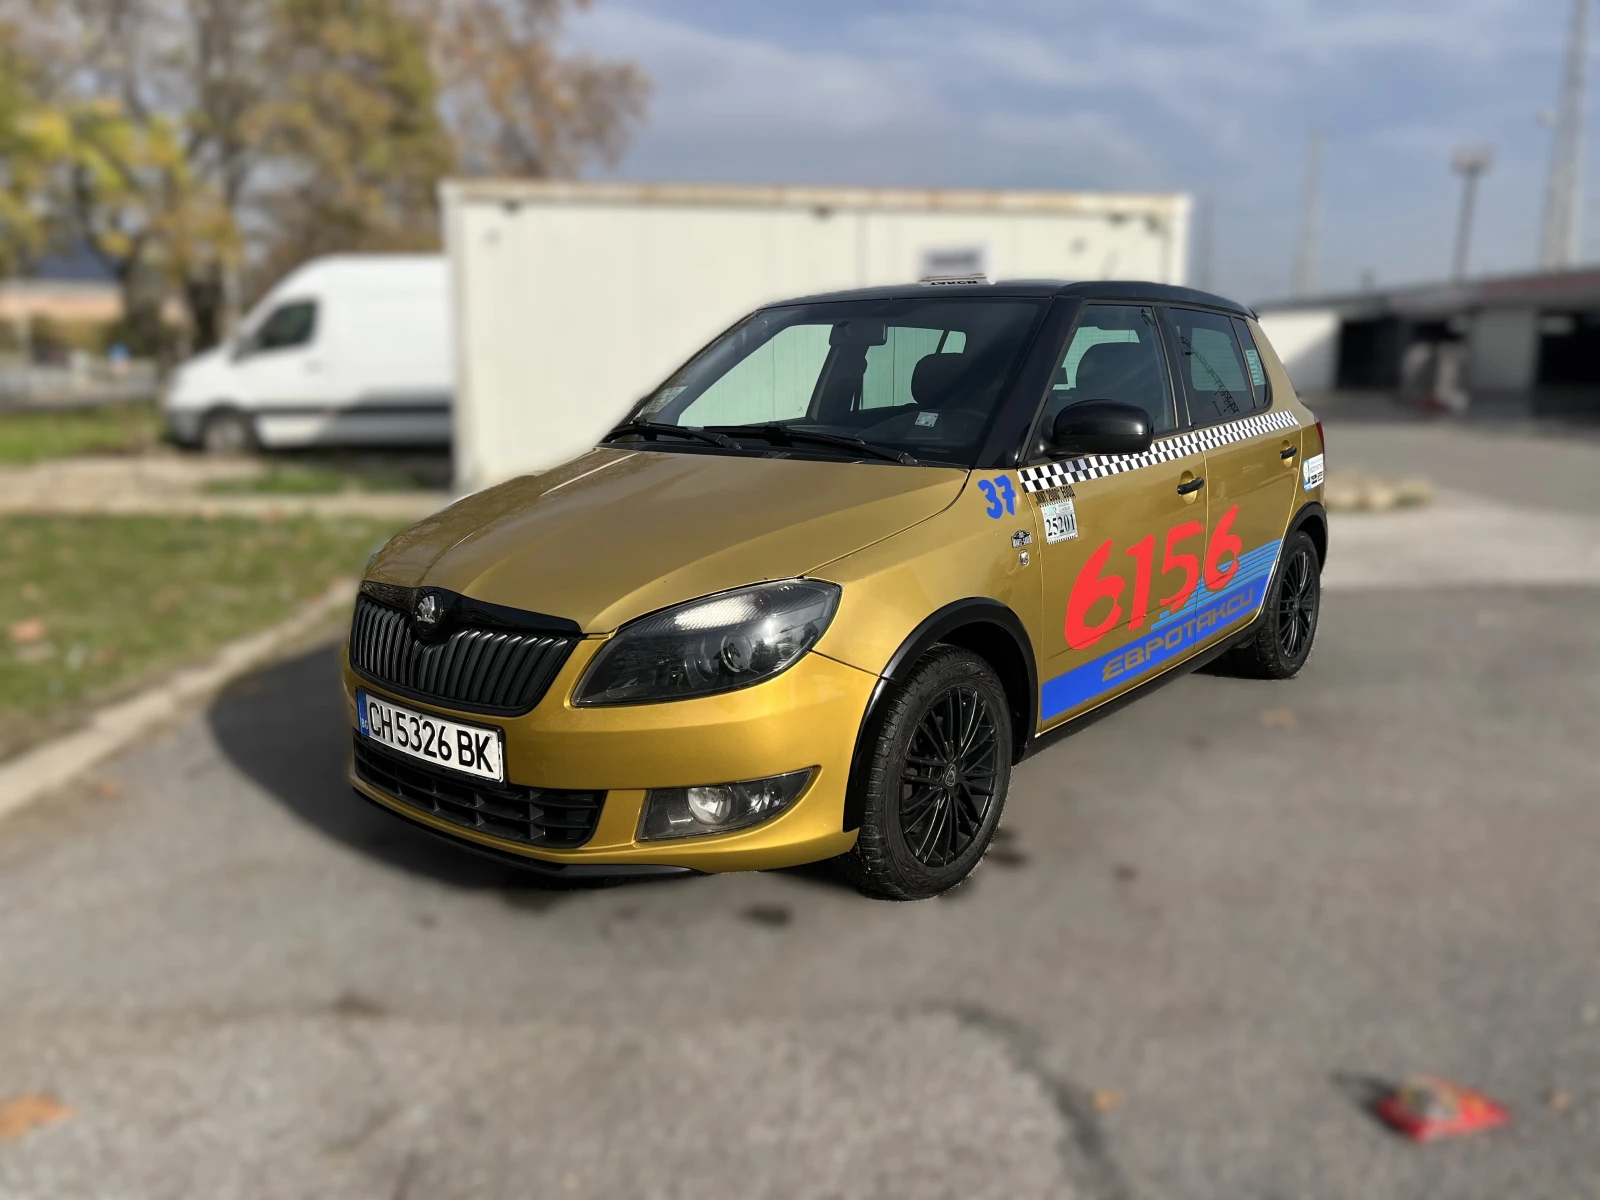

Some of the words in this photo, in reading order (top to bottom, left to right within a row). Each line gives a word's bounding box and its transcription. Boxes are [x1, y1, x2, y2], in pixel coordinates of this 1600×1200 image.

[978, 475, 1016, 519] 37
[1046, 513, 1075, 536] 25201
[1064, 505, 1242, 650] 6156
[361, 718, 369, 730] BG
[457, 729, 494, 773] BK
